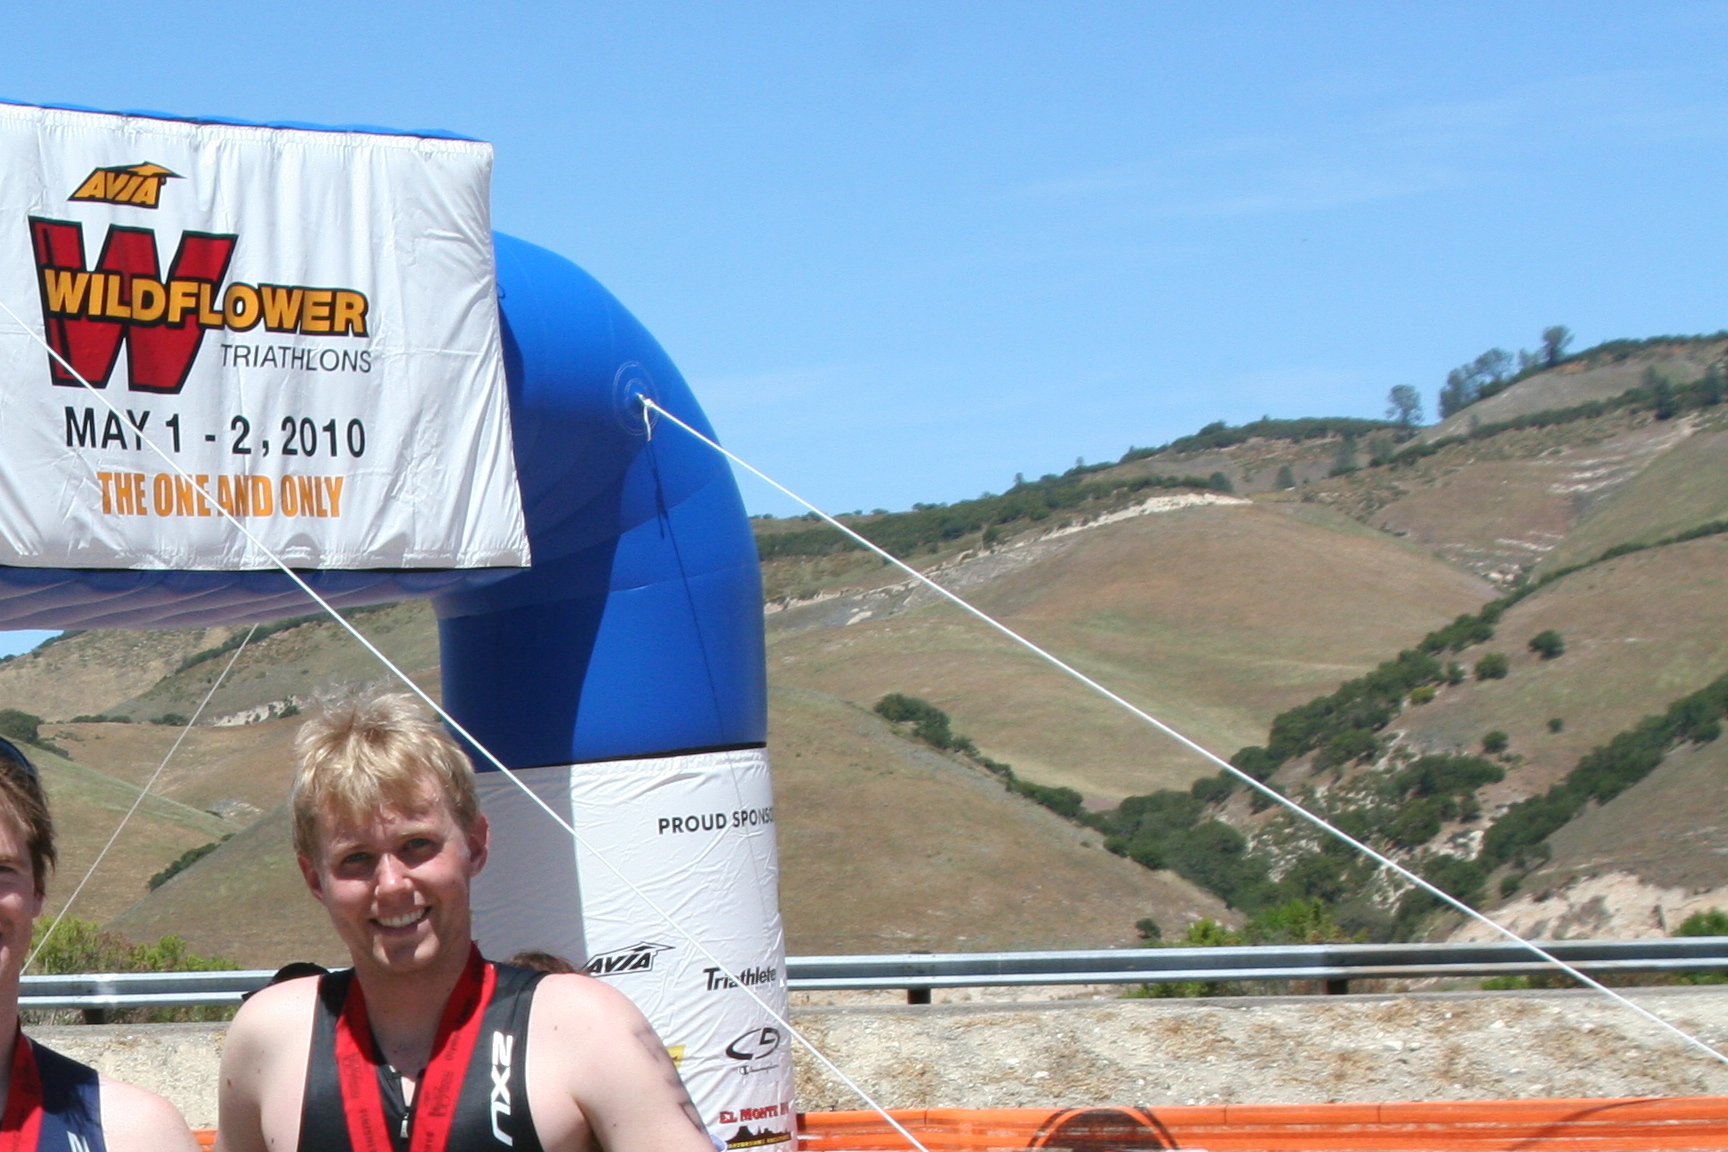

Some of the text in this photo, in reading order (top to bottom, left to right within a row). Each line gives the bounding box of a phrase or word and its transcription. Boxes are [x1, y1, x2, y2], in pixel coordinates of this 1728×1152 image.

[73, 166, 167, 206] AVIA
[42, 266, 369, 337] WILDFLOWER
[220, 343, 373, 373] TRIATHLONS
[65, 406, 150, 452] MAY
[164, 412, 181, 453] 1
[281, 415, 367, 458] 2010
[97, 471, 344, 519] THE ONE AND ONLY
[658, 812, 728, 836] PROUD
[586, 952, 652, 975] AVIA
[490, 1030, 514, 1148] 2XU
